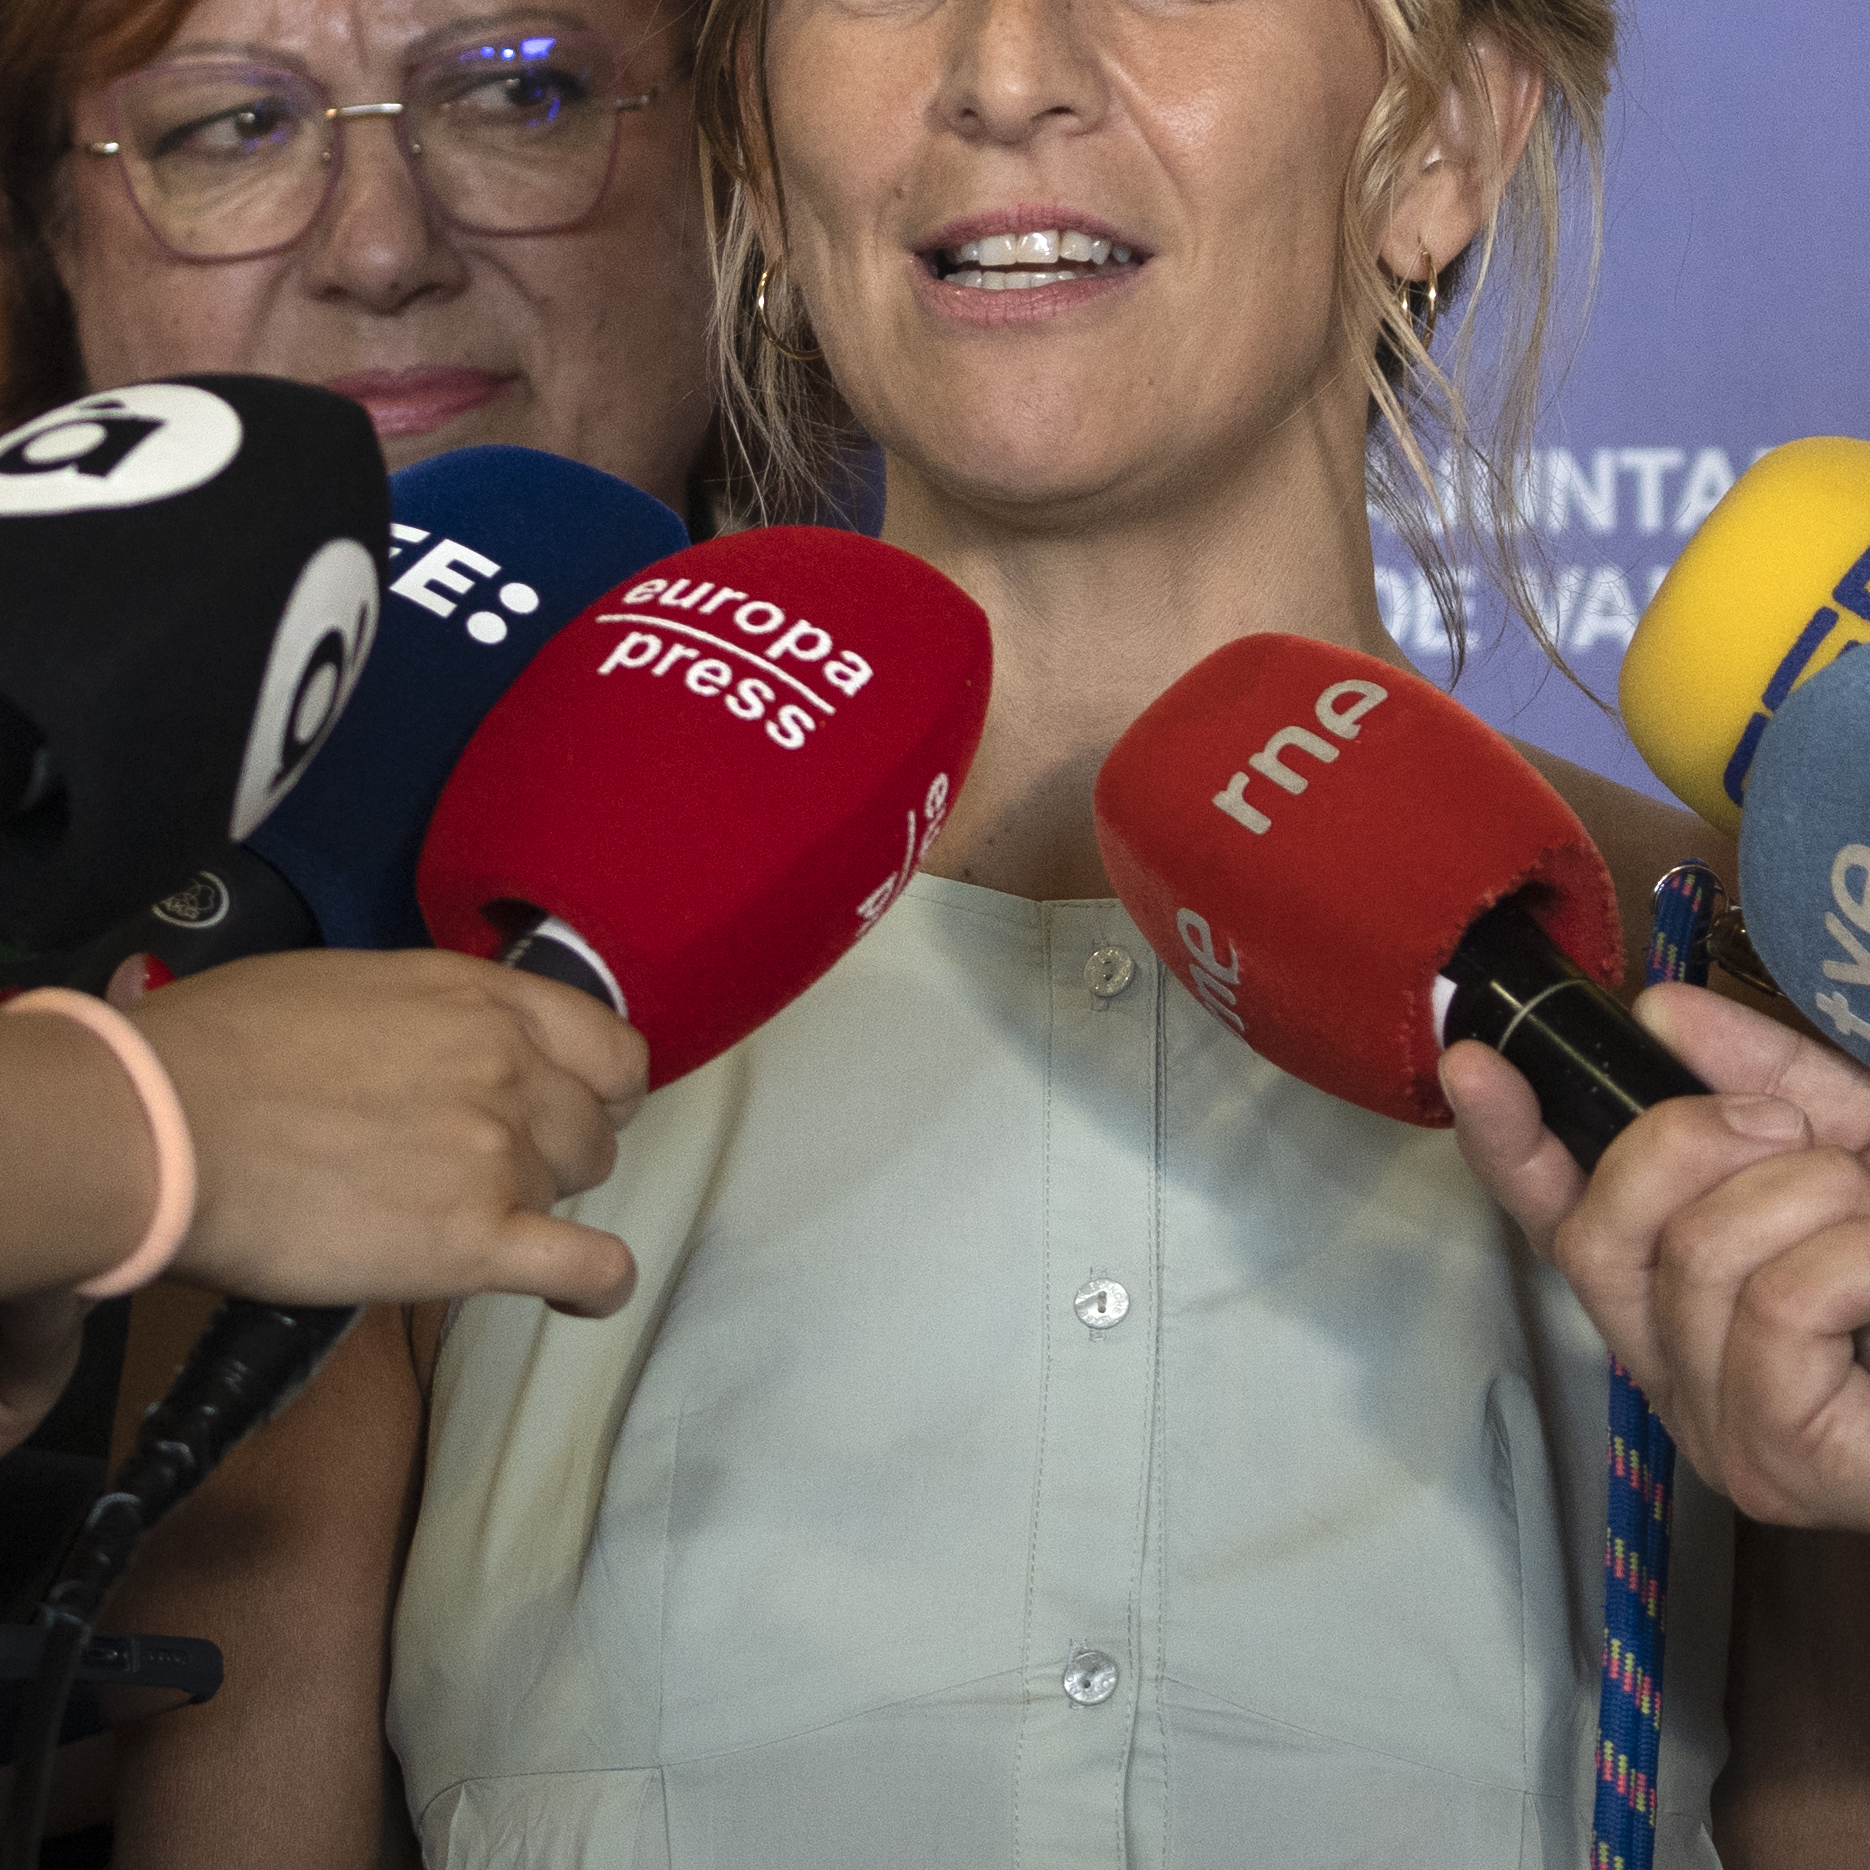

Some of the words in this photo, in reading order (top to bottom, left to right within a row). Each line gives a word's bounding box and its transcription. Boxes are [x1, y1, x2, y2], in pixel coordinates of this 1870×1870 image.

[596, 630, 817, 751] press
[622, 575, 874, 698] europa
[1211, 678, 1389, 836] rne
